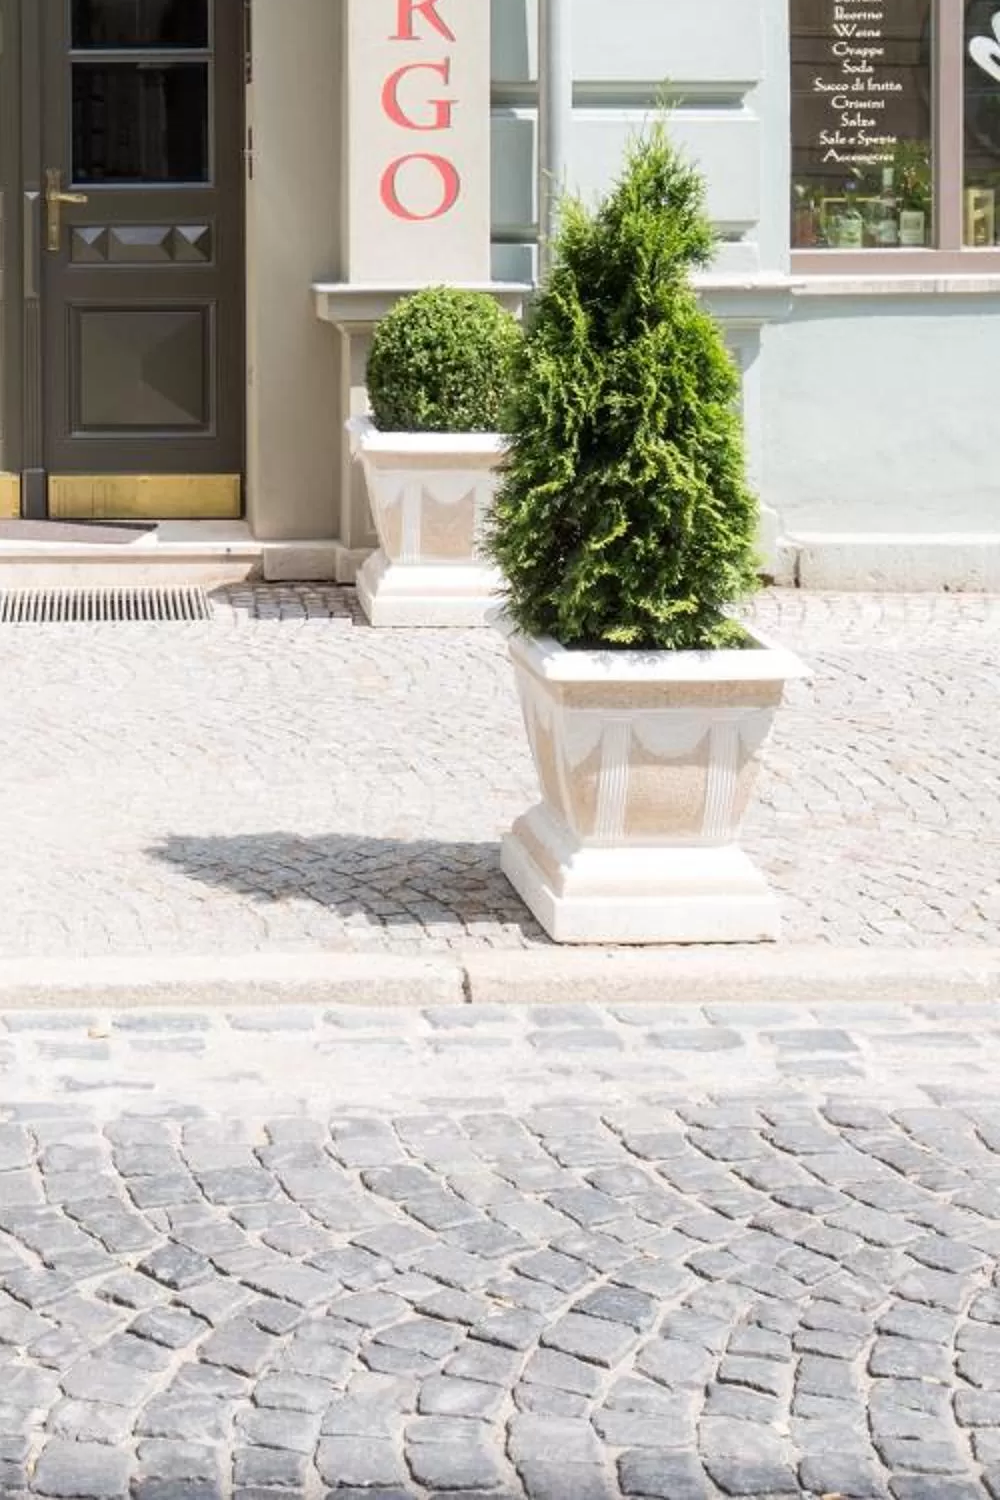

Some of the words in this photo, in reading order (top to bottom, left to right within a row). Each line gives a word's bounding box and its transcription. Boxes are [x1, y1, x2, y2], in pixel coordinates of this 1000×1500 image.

[834, 5, 883, 20] Pecorino
[832, 23, 881, 37] Weine
[841, 59, 874, 73] Soda
[813, 77, 849, 91] Succo
[851, 77, 864, 91] di
[867, 77, 903, 91] frutta
[830, 95, 885, 109] Grissini
[819, 129, 846, 144] Sale
